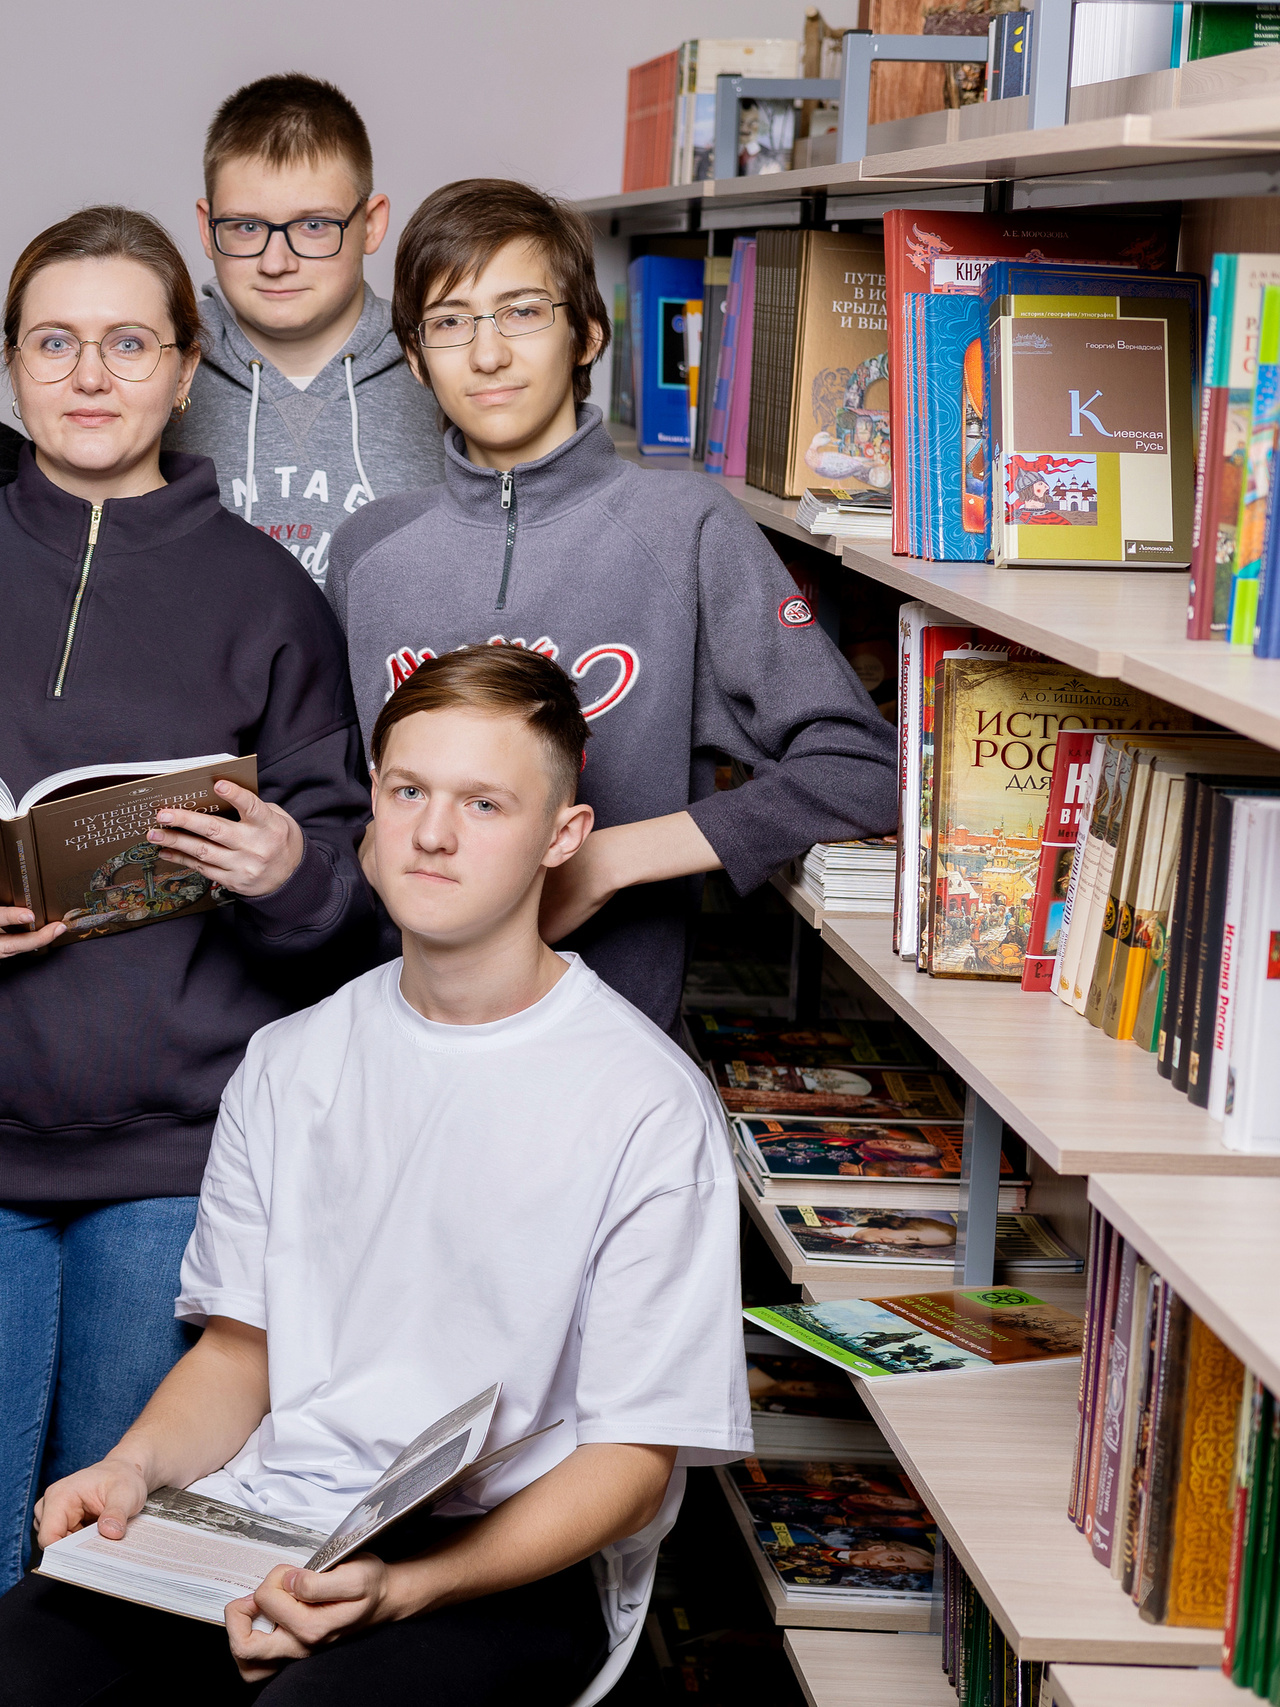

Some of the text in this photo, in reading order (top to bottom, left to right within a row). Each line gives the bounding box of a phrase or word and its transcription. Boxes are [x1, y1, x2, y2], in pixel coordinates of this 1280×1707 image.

[1021, 230, 1069, 239] МОРОЗОВА
[844, 272, 886, 286] ПУТЕ
[854, 287, 864, 299] В
[832, 301, 887, 316] КРЫЛА
[840, 316, 853, 328] И
[1117, 341, 1162, 351] Вернадский
[1068, 390, 1163, 439] Киевская
[1135, 441, 1164, 451] Русь
[257, 523, 312, 540] OKYO
[901, 653, 910, 719] История
[1020, 692, 1130, 707] А. О. ИШИМОВА
[971, 739, 1056, 772] РОС
[1006, 774, 1052, 792] ДЛЯ
[73, 790, 208, 827] ПУТЕШЕСТВИЕ
[86, 824, 96, 832] В
[75, 843, 88, 852] И
[1214, 923, 1236, 1051] История России
